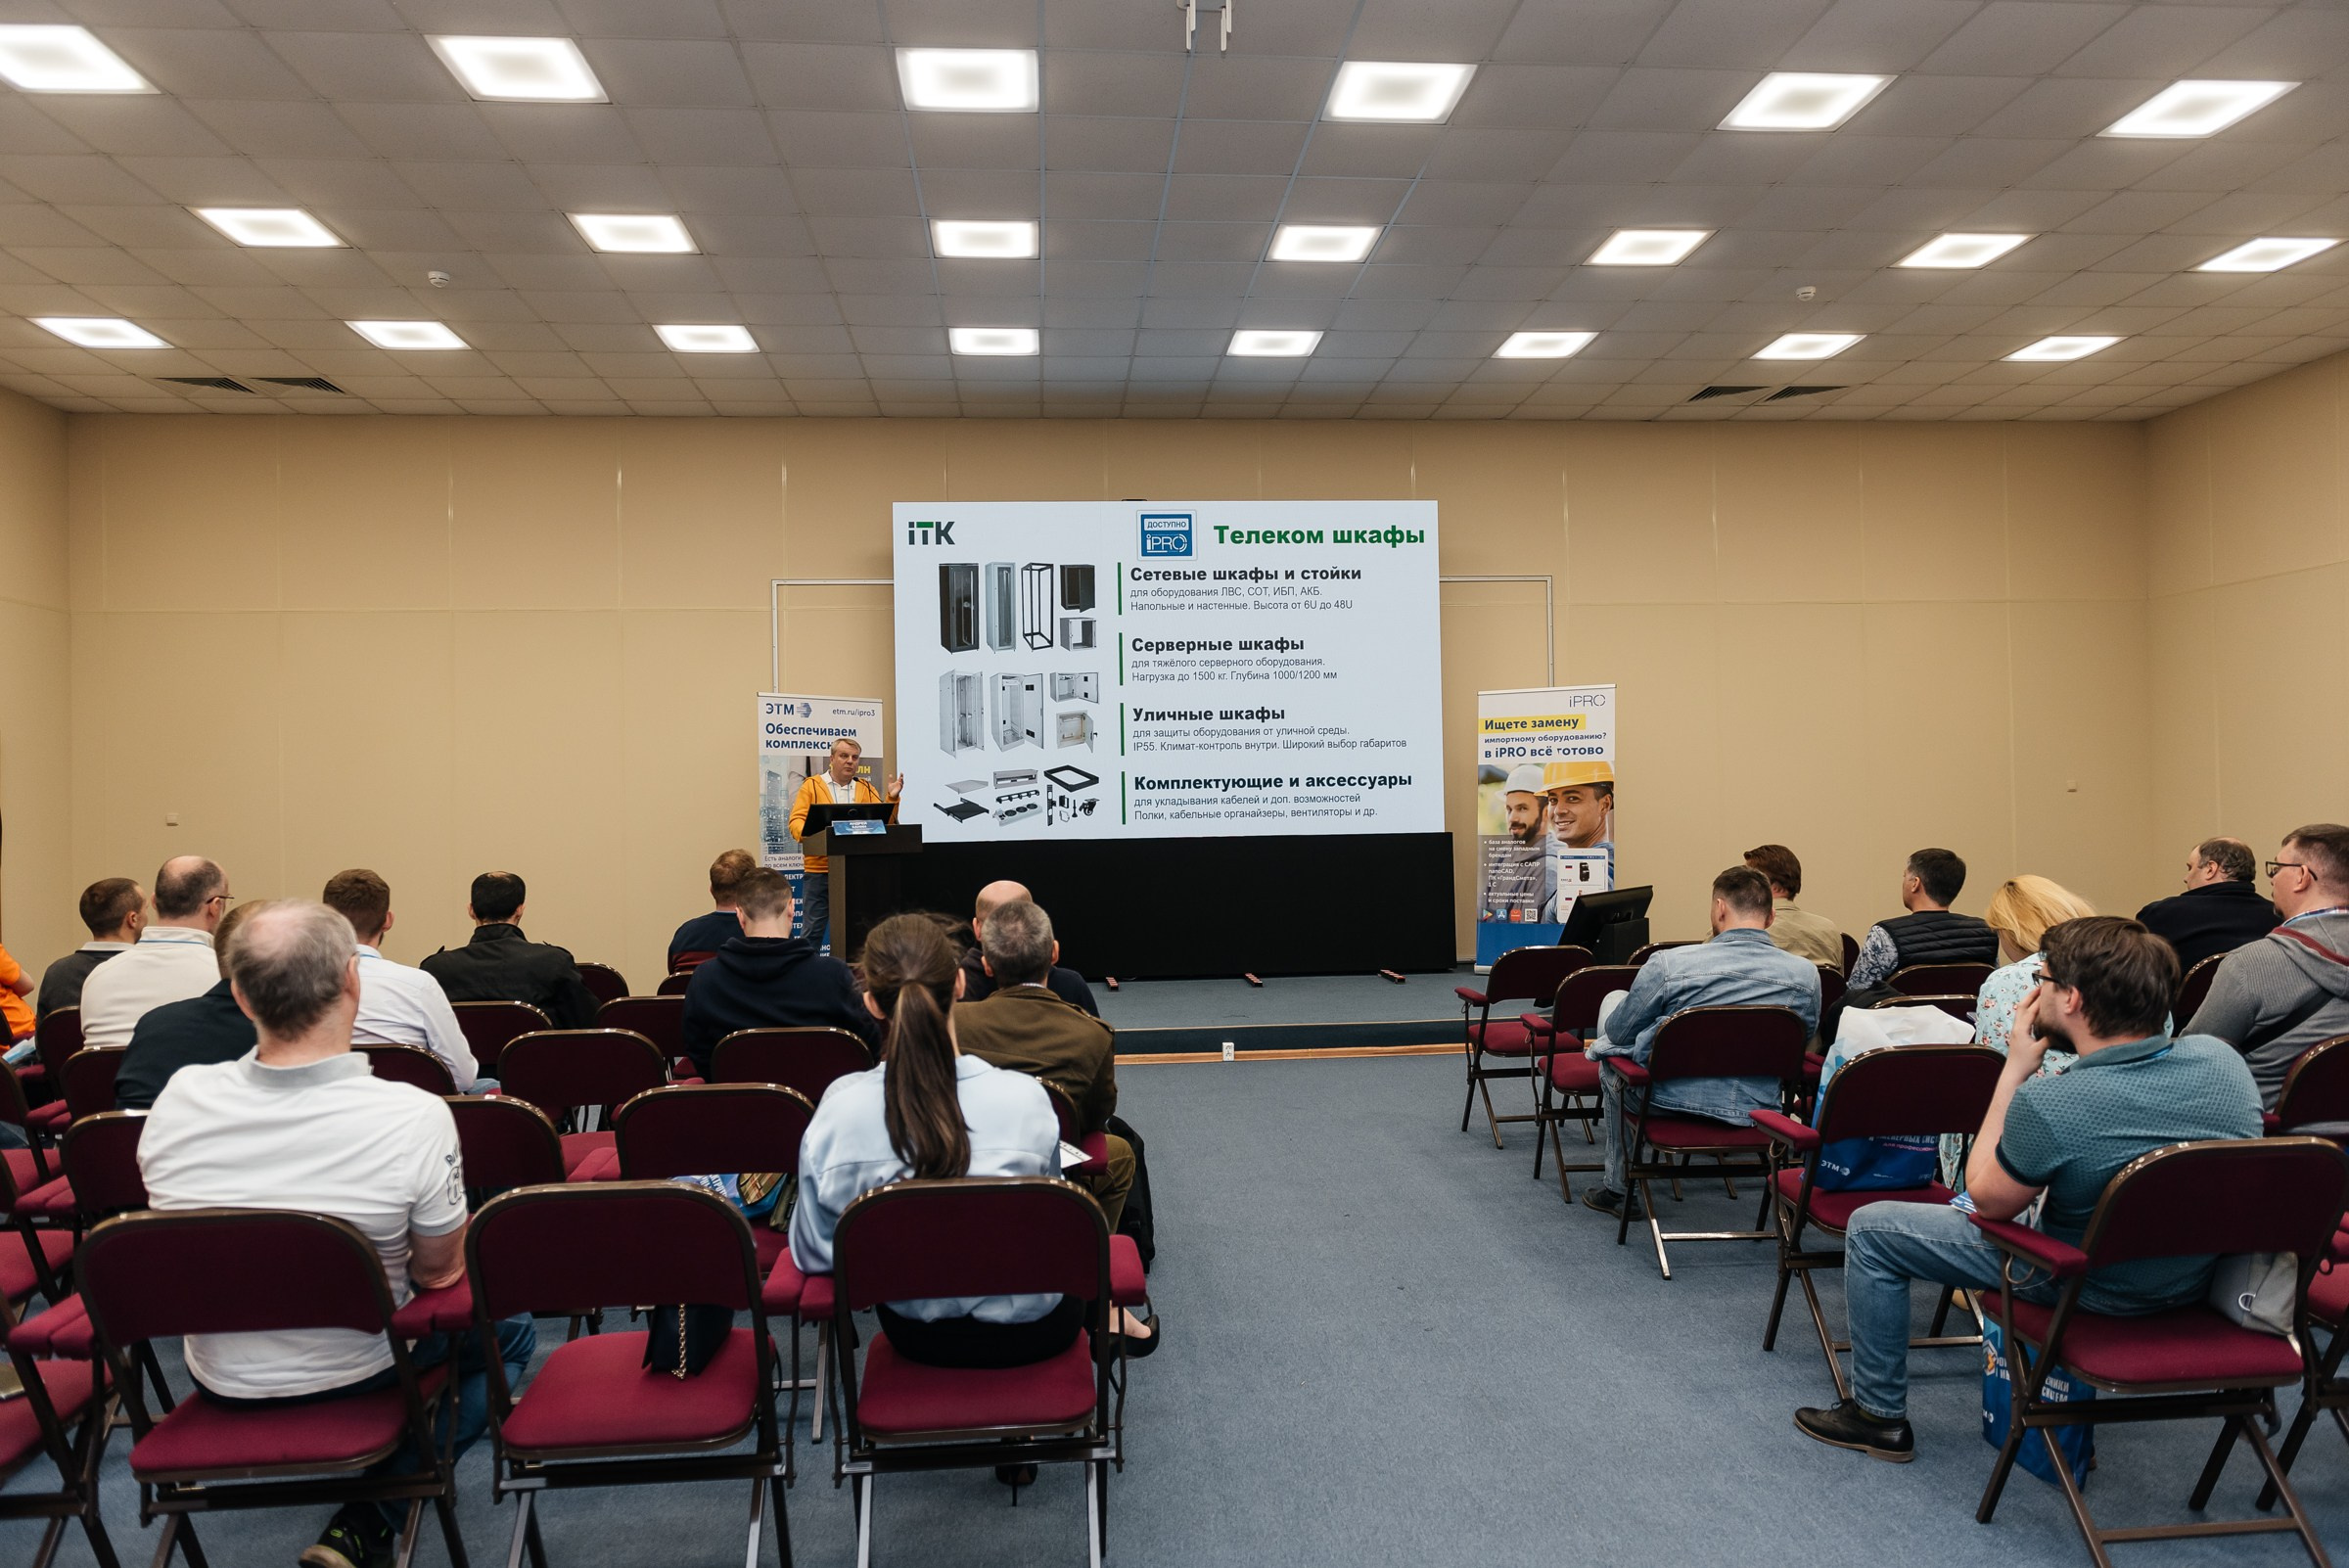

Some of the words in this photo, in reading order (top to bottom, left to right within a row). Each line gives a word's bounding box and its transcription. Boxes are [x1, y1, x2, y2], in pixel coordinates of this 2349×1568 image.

[1146, 533, 1187, 552] iPRO
[1213, 526, 1323, 544] Телеком
[1332, 525, 1424, 548] шкафы
[1129, 568, 1207, 580] Сетевые
[1212, 567, 1278, 583] шкафы
[1284, 570, 1294, 579] и
[1300, 566, 1360, 579] стойки
[1129, 589, 1148, 598] для
[1150, 586, 1219, 599] оборудования
[1221, 586, 1244, 597] ЛВС,
[1247, 586, 1269, 597] СОТ,
[1272, 585, 1297, 597] ИБП,
[1299, 585, 1322, 595] АКБ.
[1130, 600, 1185, 611] Напольные
[1253, 600, 1288, 610] Высота
[1304, 599, 1316, 609] 6U
[1318, 601, 1331, 610] до
[1333, 599, 1353, 609] 48U
[1131, 638, 1232, 654] Серверные
[1238, 637, 1304, 653] шкафы
[1130, 660, 1149, 669] для
[1151, 658, 1196, 668] тяжёлого
[1198, 659, 1253, 669] серверного
[1255, 656, 1325, 668] оборудования.
[1131, 671, 1174, 683] Нагрузка
[1176, 672, 1189, 682] до
[1192, 670, 1215, 680] 1500
[1230, 669, 1269, 682] Глубина
[1272, 669, 1320, 679] 1000/1200
[1569, 694, 1606, 707] iPRO
[765, 703, 795, 715] ЭТМ
[832, 708, 876, 717] etm.ru/ipro3
[1131, 708, 1214, 721] Уличные
[1219, 707, 1284, 723] шкафы
[765, 722, 857, 737] Обеспечиваем
[1485, 719, 1528, 731] Ищете
[1531, 718, 1579, 729] замену
[1131, 729, 1150, 739] для
[1153, 729, 1190, 738] защиты
[1192, 726, 1260, 738] оборудования
[1275, 725, 1314, 737] уличной
[1316, 726, 1349, 736] среды.
[1484, 735, 1536, 744] импортному
[1538, 732, 1607, 743] оборудованию?
[765, 739, 833, 750] комплексн
[1133, 741, 1157, 751] IP55.
[1160, 741, 1242, 752] Климат-контроль
[1244, 741, 1279, 752] внутри.
[1282, 738, 1324, 751] Широкий
[1326, 738, 1357, 750] выбор
[1359, 737, 1406, 750] габаритов
[1495, 747, 1527, 758] iPRO
[1530, 746, 1553, 757] всё
[1133, 776, 1283, 792] Комплектующие
[1289, 777, 1299, 787] и
[1305, 775, 1411, 790] аксессуары
[1133, 798, 1152, 807] для
[1154, 797, 1218, 807] укладывания
[1221, 794, 1260, 805] кабелей
[1269, 796, 1290, 805] доп.
[1293, 792, 1360, 803] возможностей
[1134, 809, 1167, 820] Полки,
[1169, 808, 1221, 819] кабельные
[1223, 807, 1287, 820] органайзеры,
[1290, 808, 1352, 818] вентиляторы
[1362, 807, 1377, 817] др.
[1820, 1160, 1840, 1173] ЭТМ
